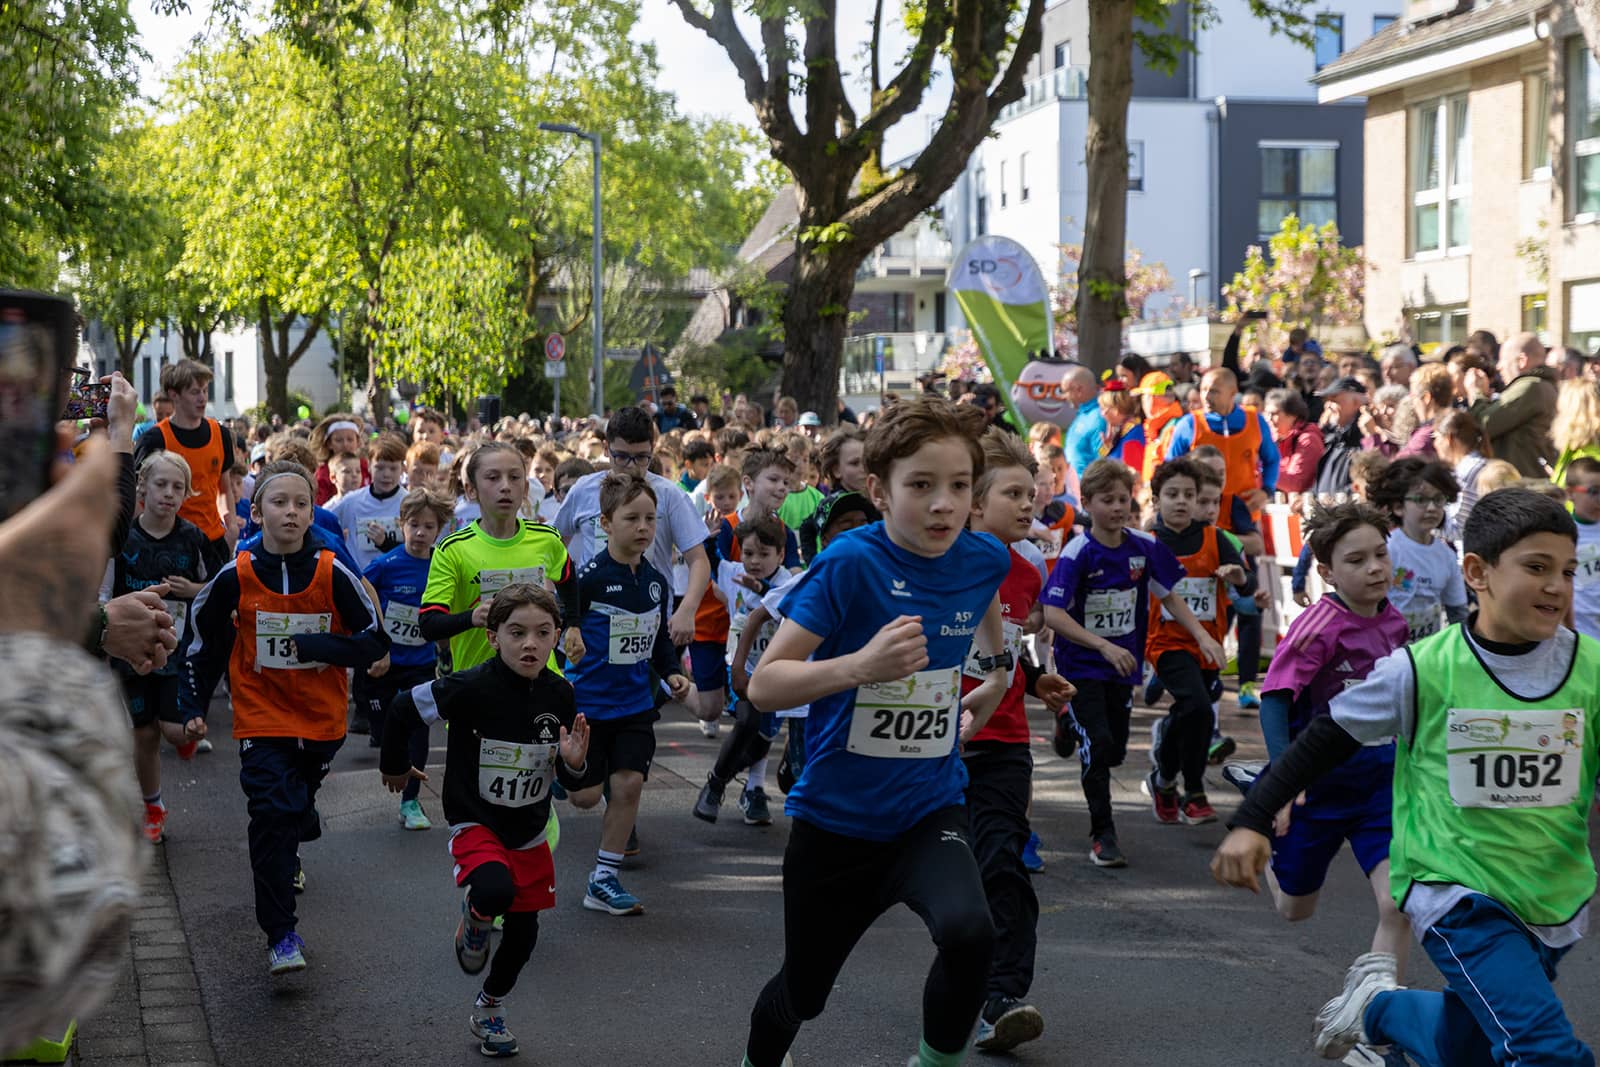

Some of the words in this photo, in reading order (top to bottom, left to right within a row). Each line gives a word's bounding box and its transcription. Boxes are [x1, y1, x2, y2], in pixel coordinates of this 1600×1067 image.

[968, 259, 997, 275] SD
[606, 584, 623, 593] JAKO
[955, 611, 974, 622] ASV
[390, 620, 423, 638] 276
[266, 637, 292, 658] 13
[870, 708, 952, 741] 2025
[1449, 724, 1470, 734] SD
[1469, 753, 1563, 788] 1052
[488, 776, 544, 801] 4110
[1490, 793, 1543, 803] Muhamad
